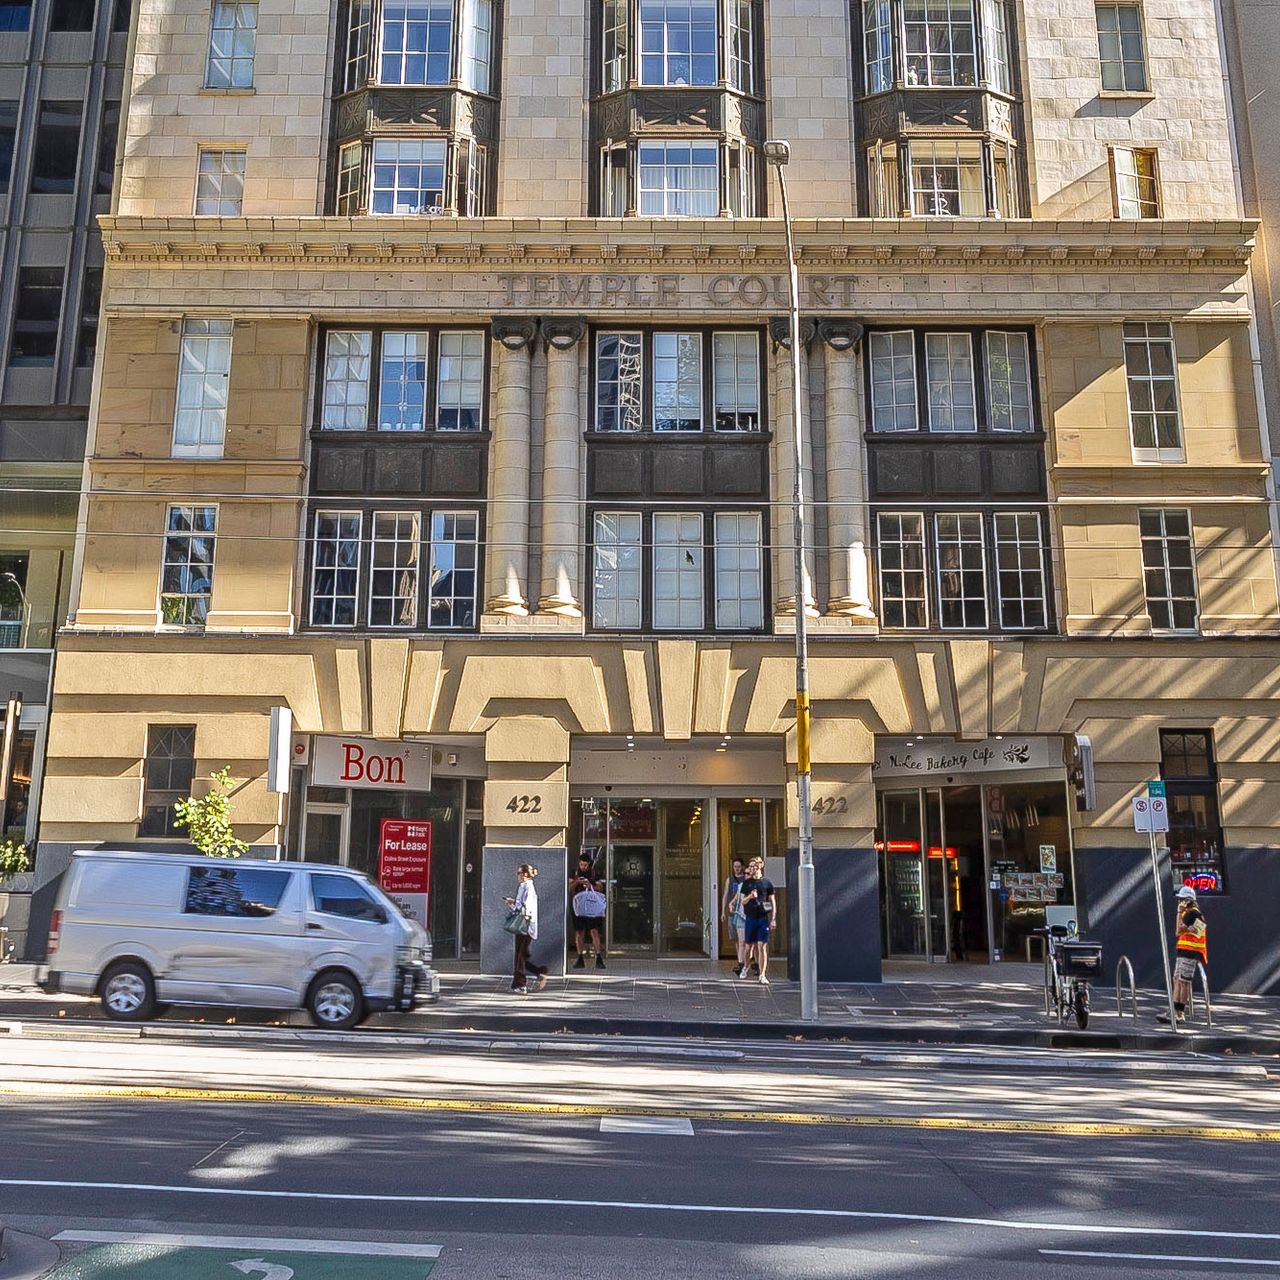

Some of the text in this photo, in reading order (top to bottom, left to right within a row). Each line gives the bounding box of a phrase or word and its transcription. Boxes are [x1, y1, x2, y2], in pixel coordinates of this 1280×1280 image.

[496, 274, 860, 308] TEMPLE COURT
[506, 794, 543, 814] 422
[811, 796, 850, 816] 422
[385, 839, 428, 851] For Lease
[1184, 877, 1217, 890] OPEN
